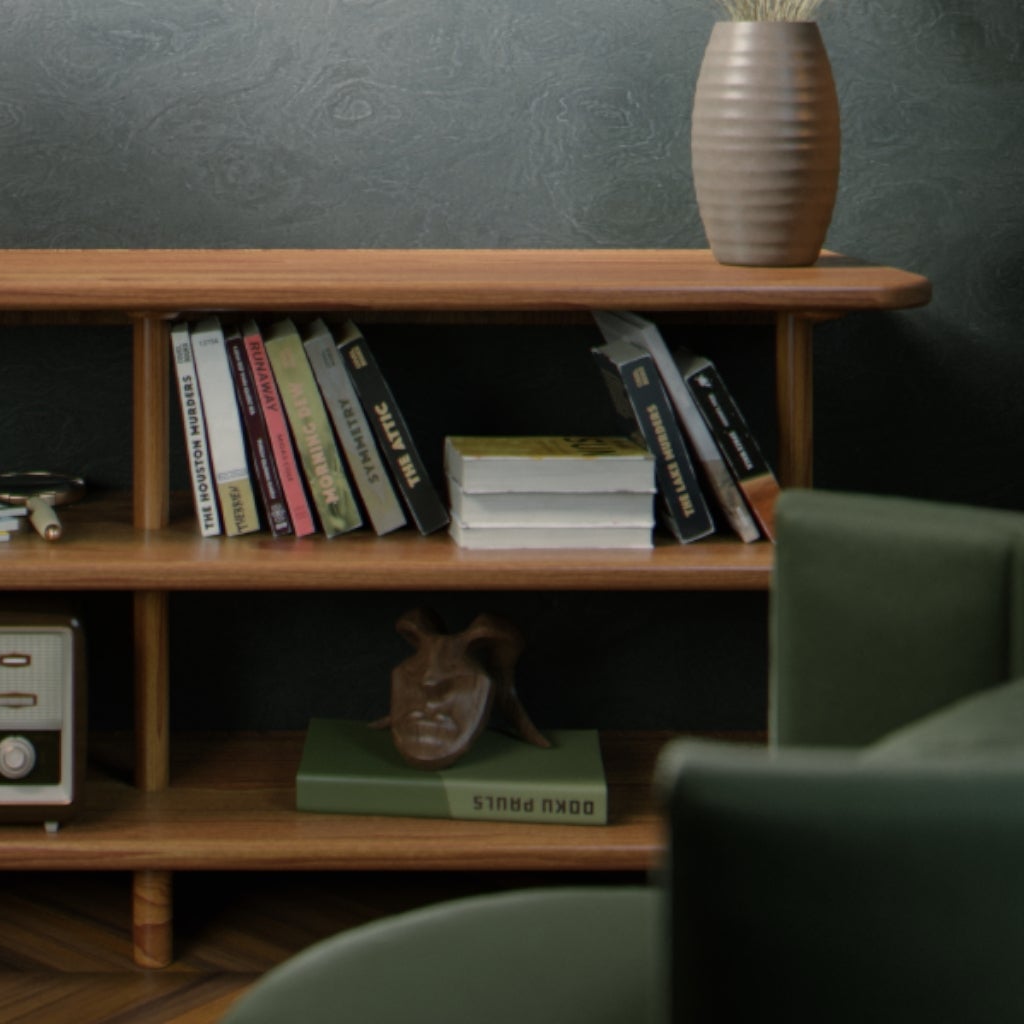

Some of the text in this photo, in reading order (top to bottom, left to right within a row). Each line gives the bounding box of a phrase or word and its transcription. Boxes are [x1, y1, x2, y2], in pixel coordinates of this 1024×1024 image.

[249, 342, 277, 411] RUNAWAY
[287, 382, 312, 419] DEW
[182, 375, 214, 530] THE HOUSTON MURDERS
[301, 422, 339, 504] MORNING
[338, 399, 379, 484] SYMMETRY
[374, 401, 420, 489] THE ATTIC
[646, 403, 695, 519] THE LAKE MURDERS
[473, 795, 595, 815] DOKU PAULS
